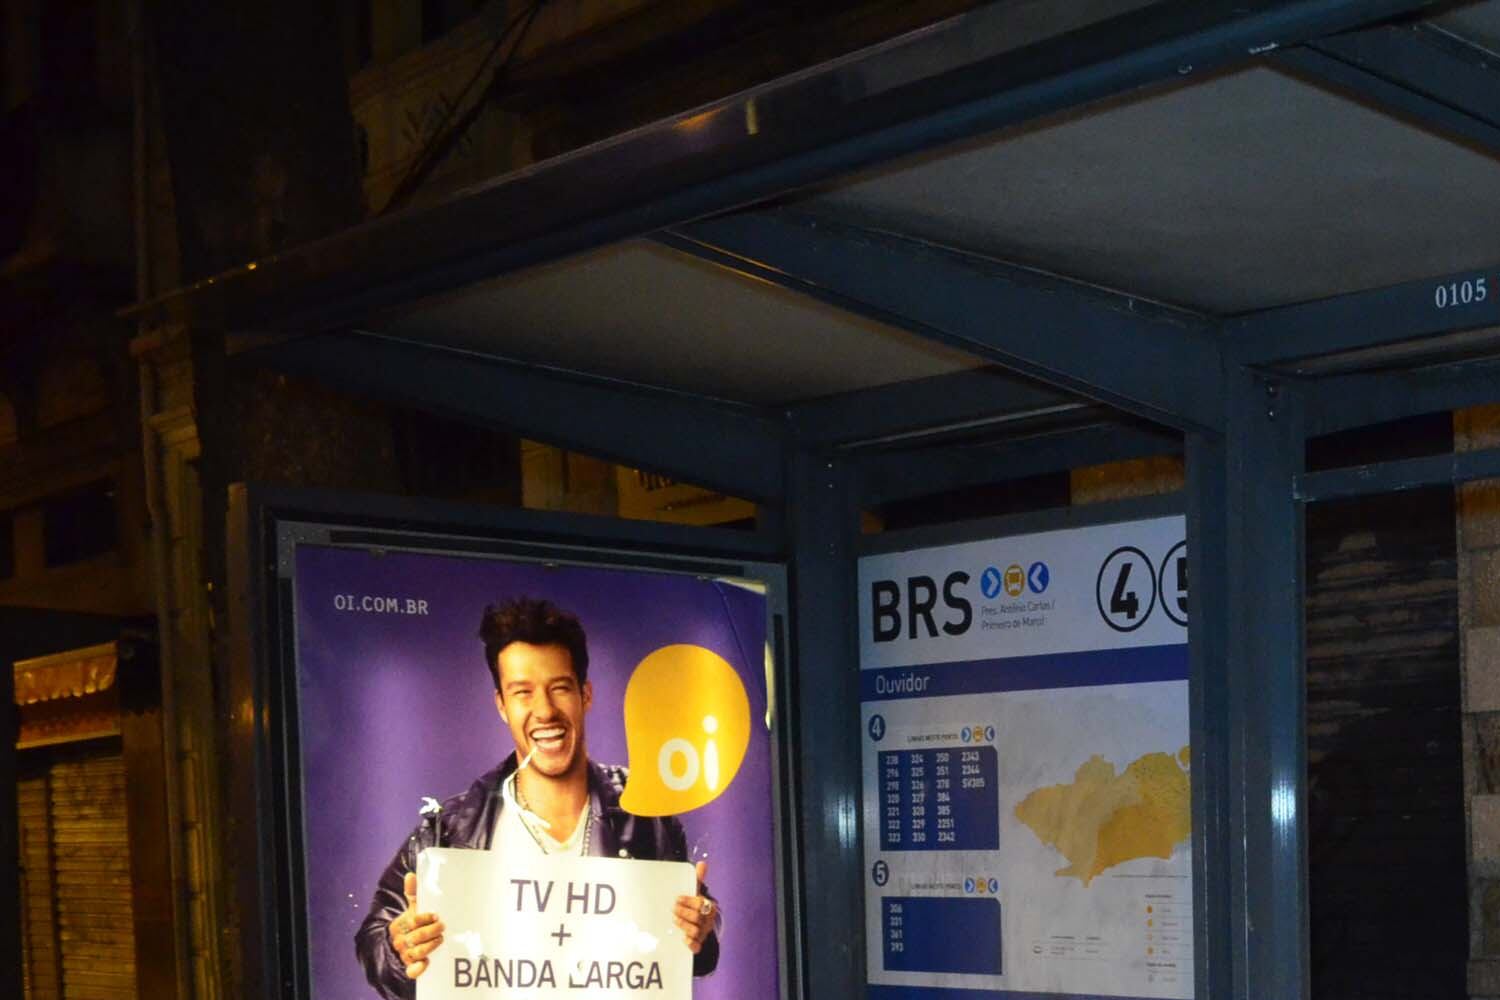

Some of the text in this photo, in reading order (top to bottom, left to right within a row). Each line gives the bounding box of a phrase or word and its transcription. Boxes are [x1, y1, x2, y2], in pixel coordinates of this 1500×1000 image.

[1435, 278, 1487, 309] 0105
[333, 594, 429, 616] OI.COM.BR
[872, 570, 974, 643] BRS
[875, 672, 931, 694] Ouvidor
[657, 714, 720, 793] oi
[510, 879, 617, 914] TV HD
[454, 957, 556, 989] BANDA
